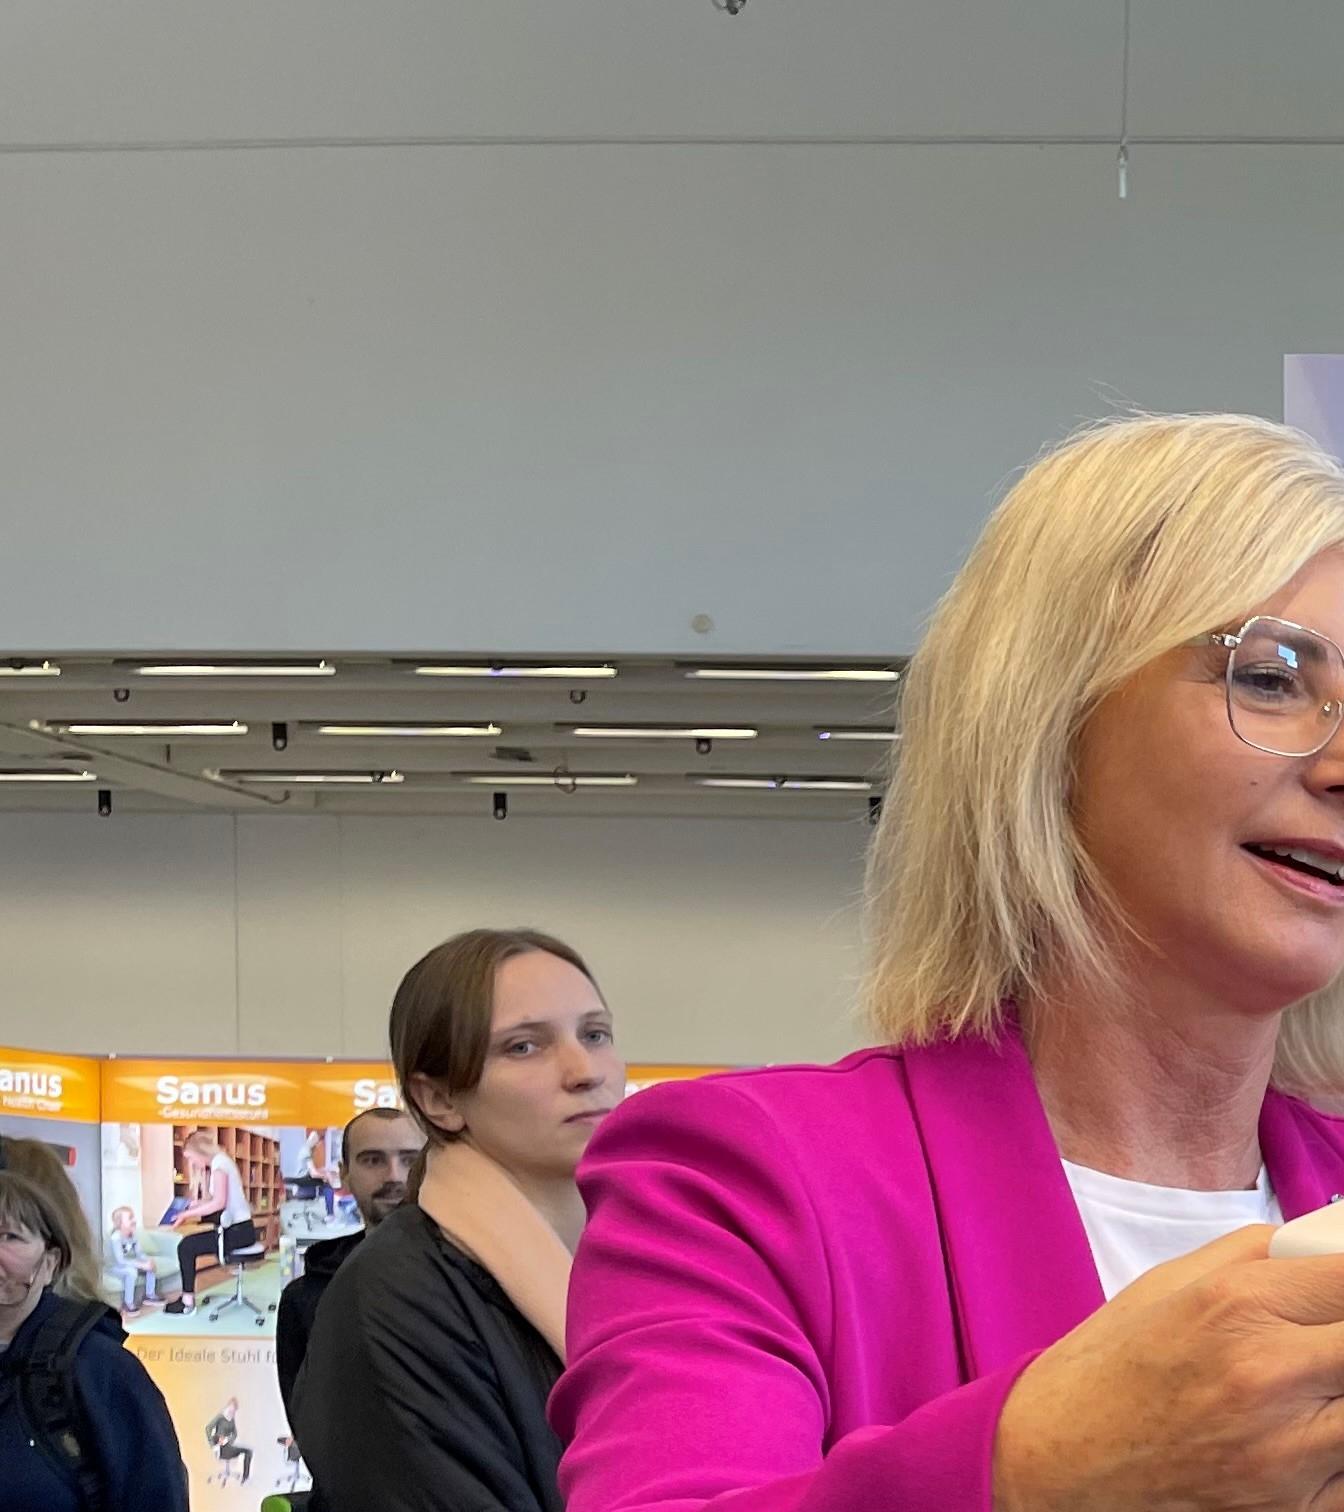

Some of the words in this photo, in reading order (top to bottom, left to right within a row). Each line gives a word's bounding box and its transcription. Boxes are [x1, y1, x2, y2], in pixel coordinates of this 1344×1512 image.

[156, 1075, 266, 1106] Sanus
[169, 1346, 215, 1363] Ideale
[220, 1349, 260, 1364] Stuhl
